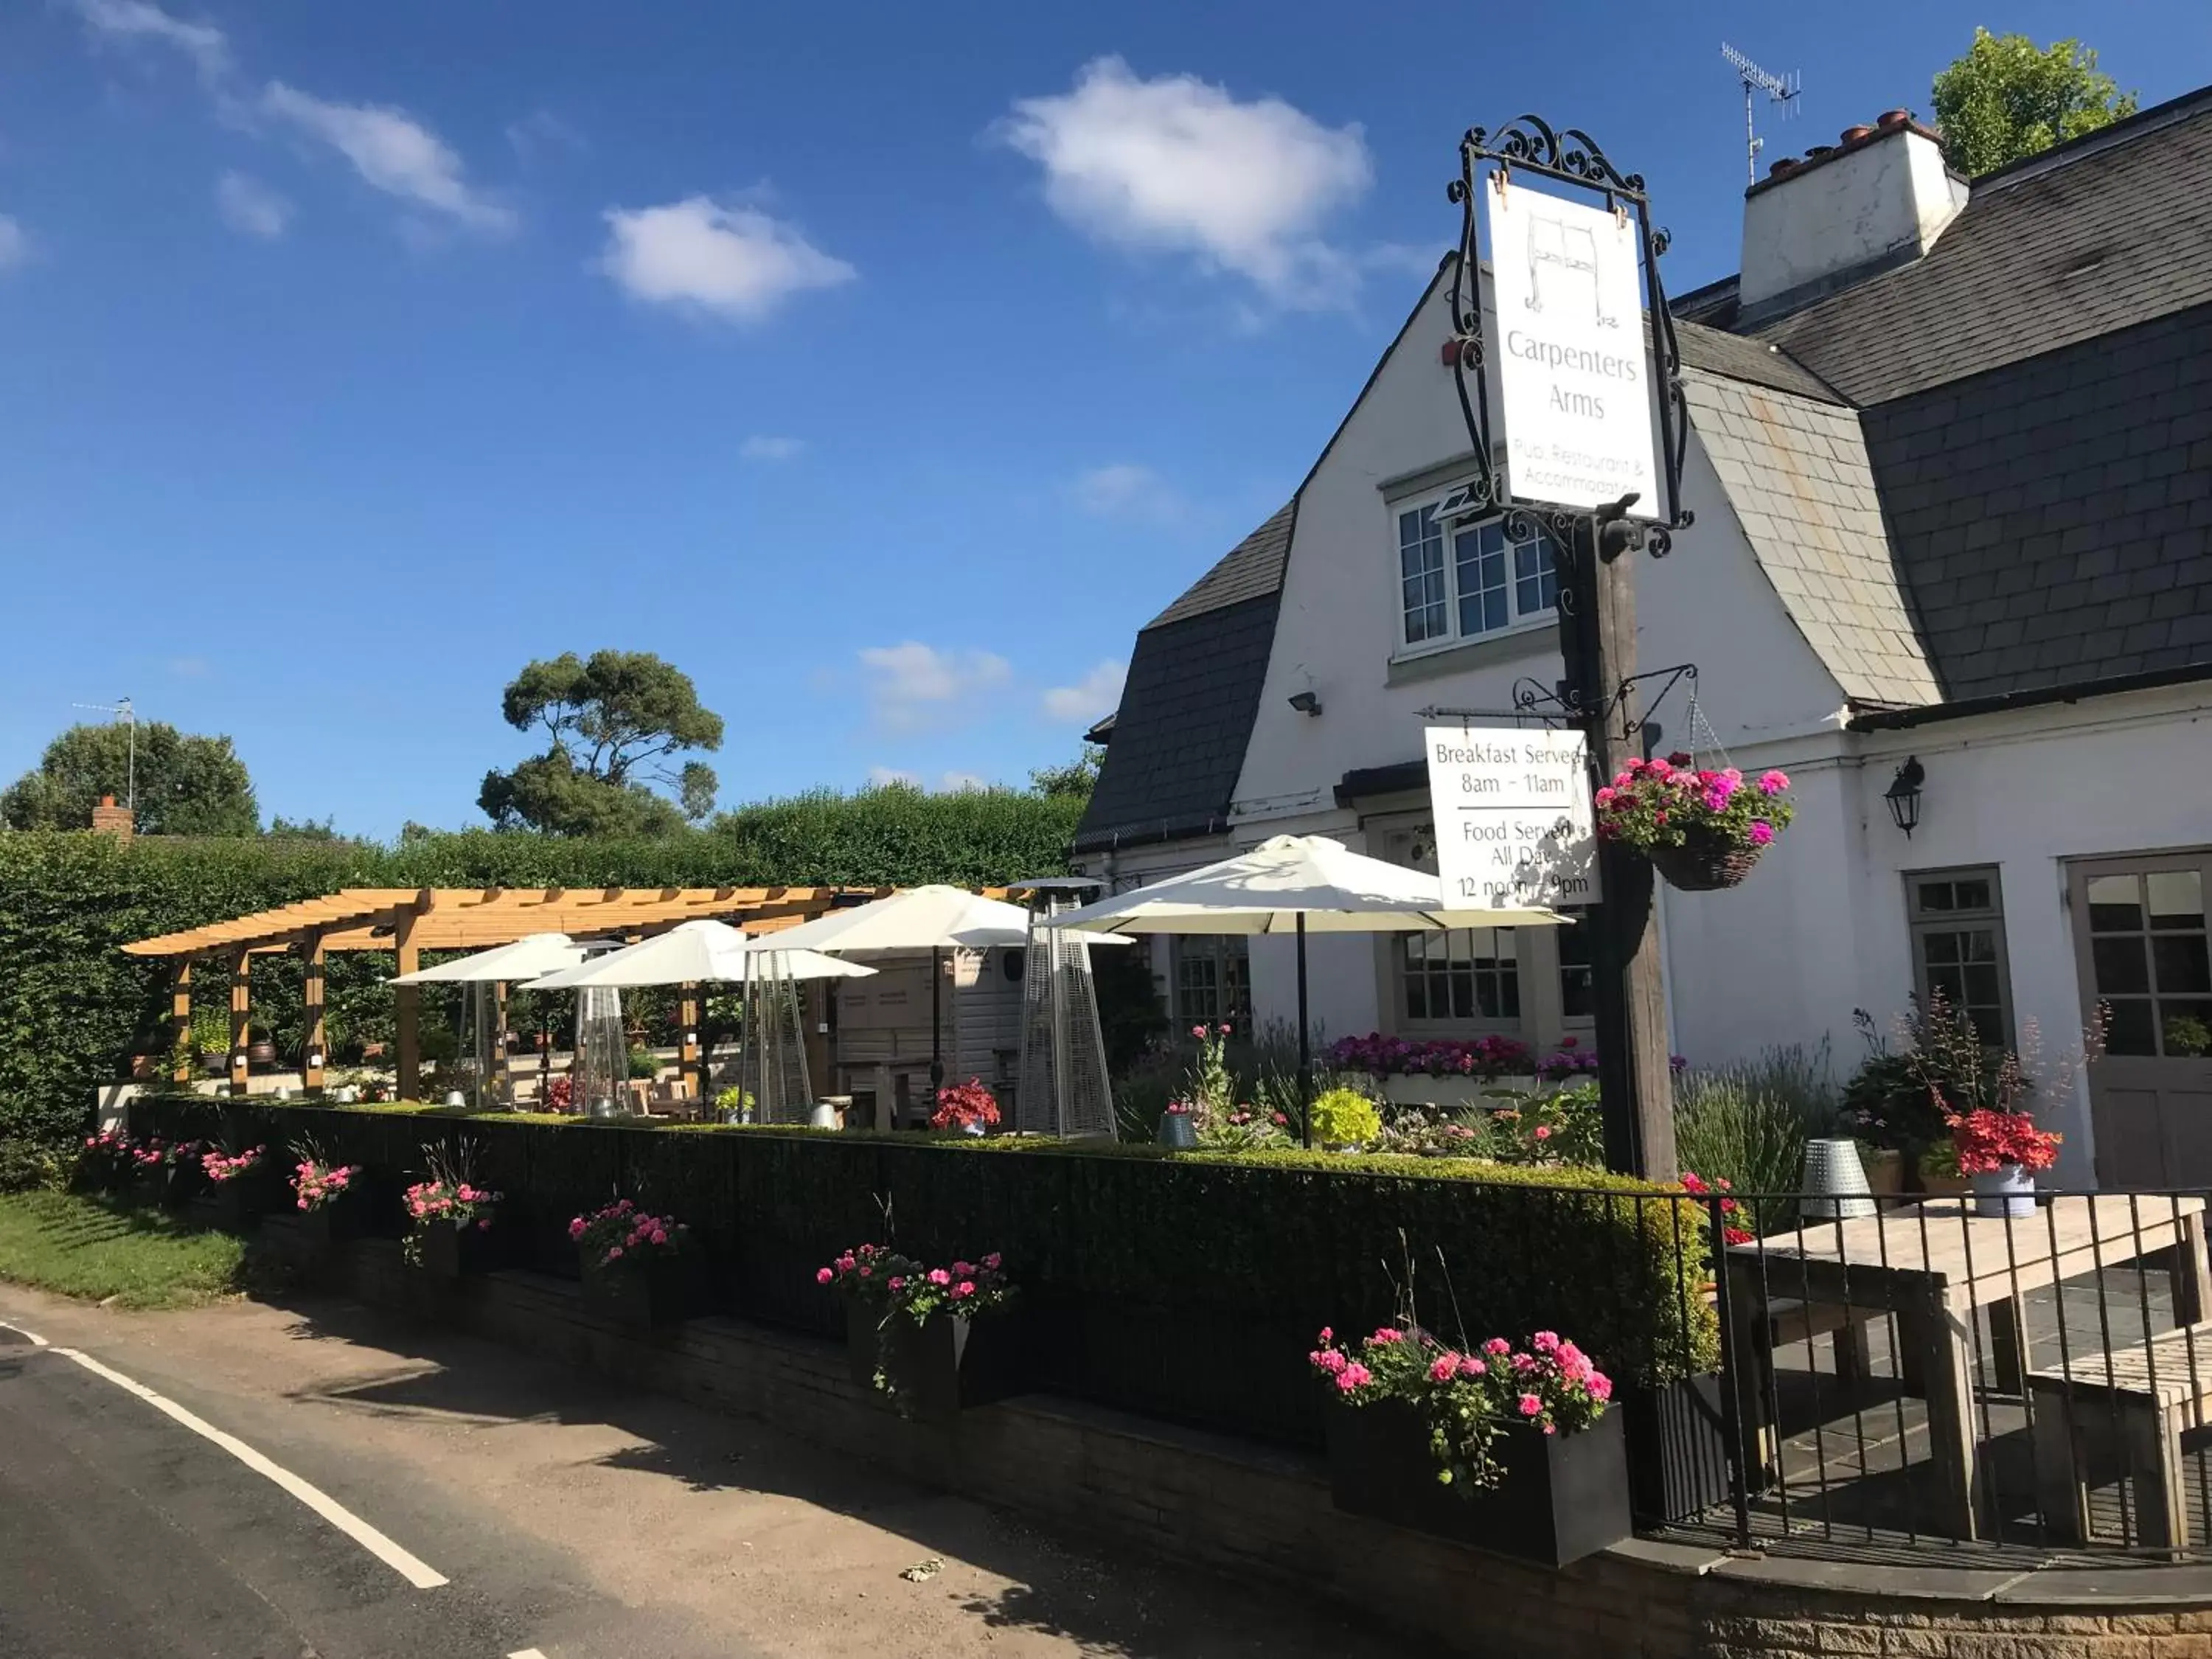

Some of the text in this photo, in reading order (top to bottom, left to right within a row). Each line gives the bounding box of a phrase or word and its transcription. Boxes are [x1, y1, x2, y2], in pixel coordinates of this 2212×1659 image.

[1508, 330, 1637, 382] Carpenters
[1549, 383, 1604, 420] Arms
[1551, 443, 1629, 473] Restaurant
[1635, 458, 1644, 477] &
[1436, 742, 1582, 765] Breakfast Served
[1461, 773, 1500, 793] 8am
[1524, 773, 1565, 793] 11am
[1464, 820, 1571, 841] Food Served
[1492, 846, 1553, 866] All Day
[1458, 877, 1477, 897] 12
[1484, 880, 1528, 897] noon
[1551, 874, 1589, 899] 9pm
